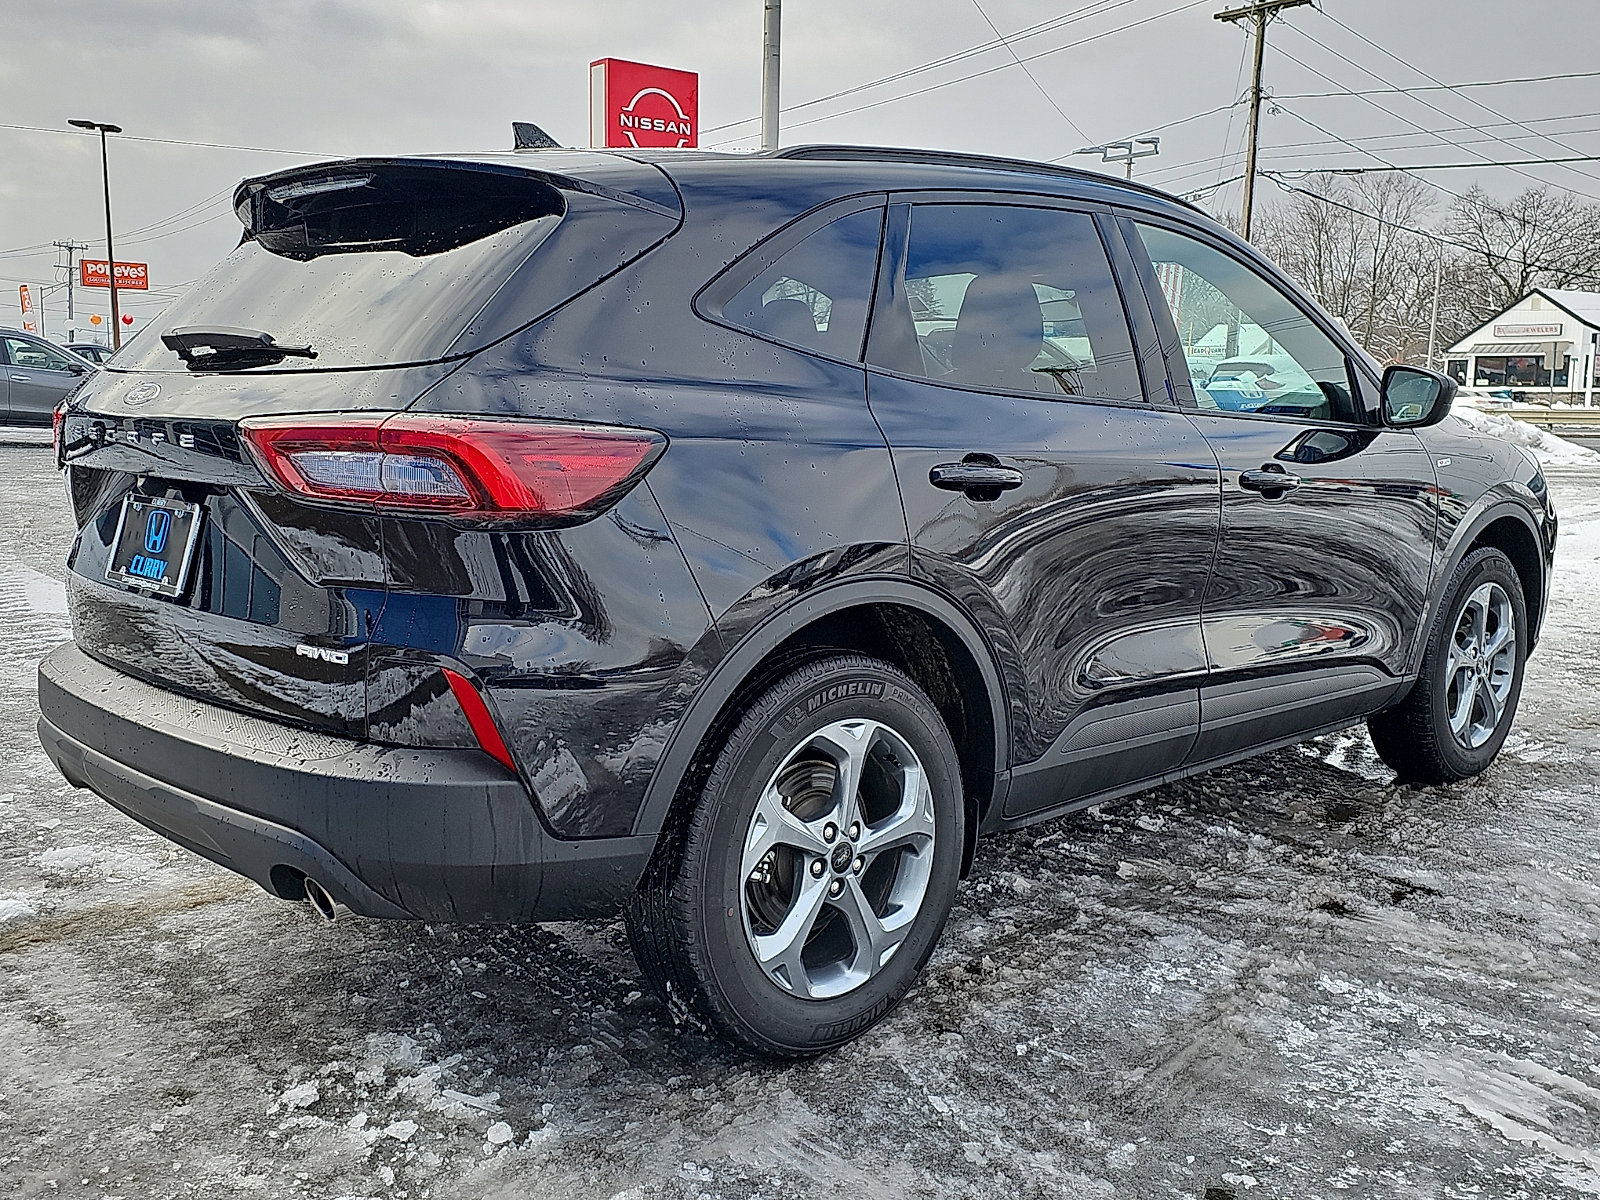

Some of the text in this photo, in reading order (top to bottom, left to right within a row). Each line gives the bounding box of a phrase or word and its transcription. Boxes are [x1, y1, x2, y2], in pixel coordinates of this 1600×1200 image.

[619, 113, 691, 135] NISSAN
[1522, 326, 1558, 334] JEWELERS
[129, 554, 168, 579] CURRY
[296, 644, 349, 665] AWD
[807, 682, 883, 711] MICHELIN
